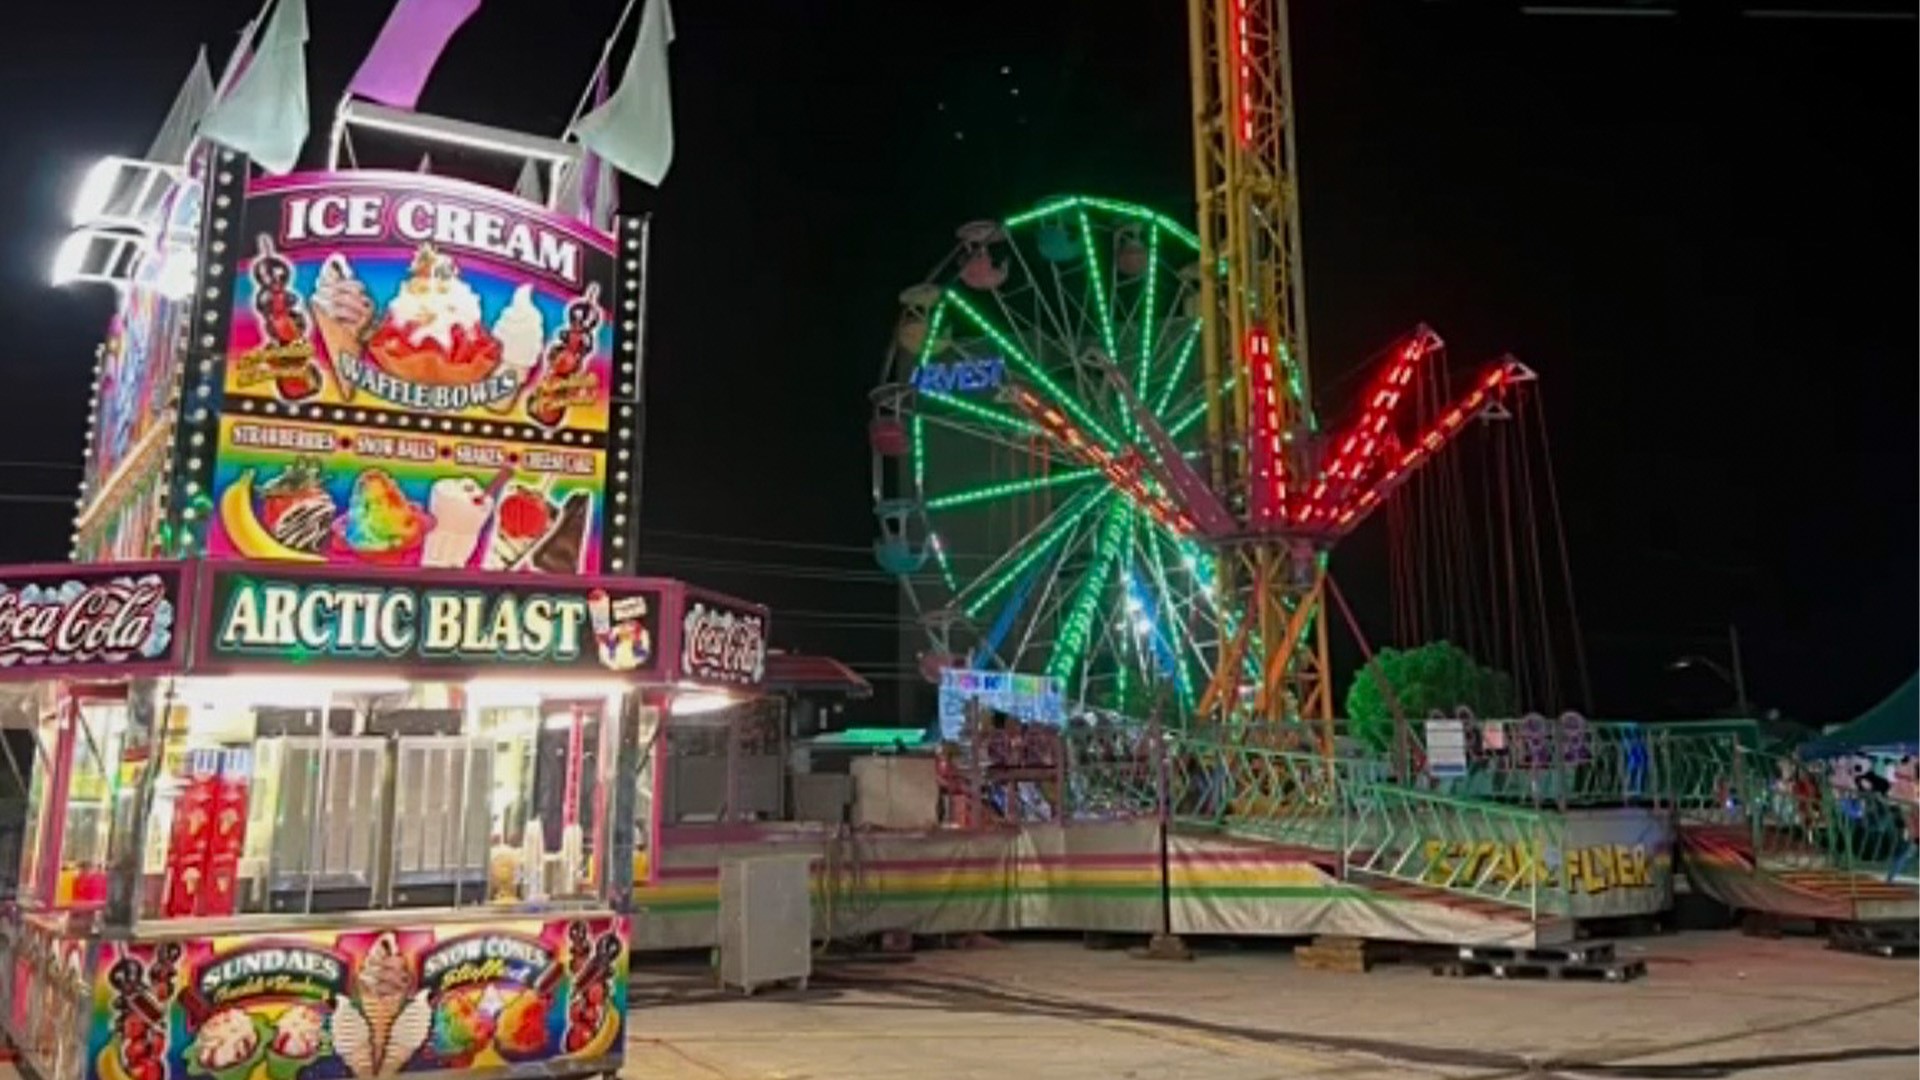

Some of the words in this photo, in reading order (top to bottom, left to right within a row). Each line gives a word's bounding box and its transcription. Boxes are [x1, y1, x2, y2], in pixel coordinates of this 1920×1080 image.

[287, 196, 383, 240] ICE
[398, 199, 578, 282] CREAM
[339, 354, 429, 407] WAFFLE
[433, 370, 517, 408] BOWLS
[223, 586, 414, 649] ARCTIC
[425, 595, 585, 652] BLAST
[203, 949, 340, 992] SUNDAES
[424, 939, 482, 978] SNOW
[486, 936, 548, 968] CONES
